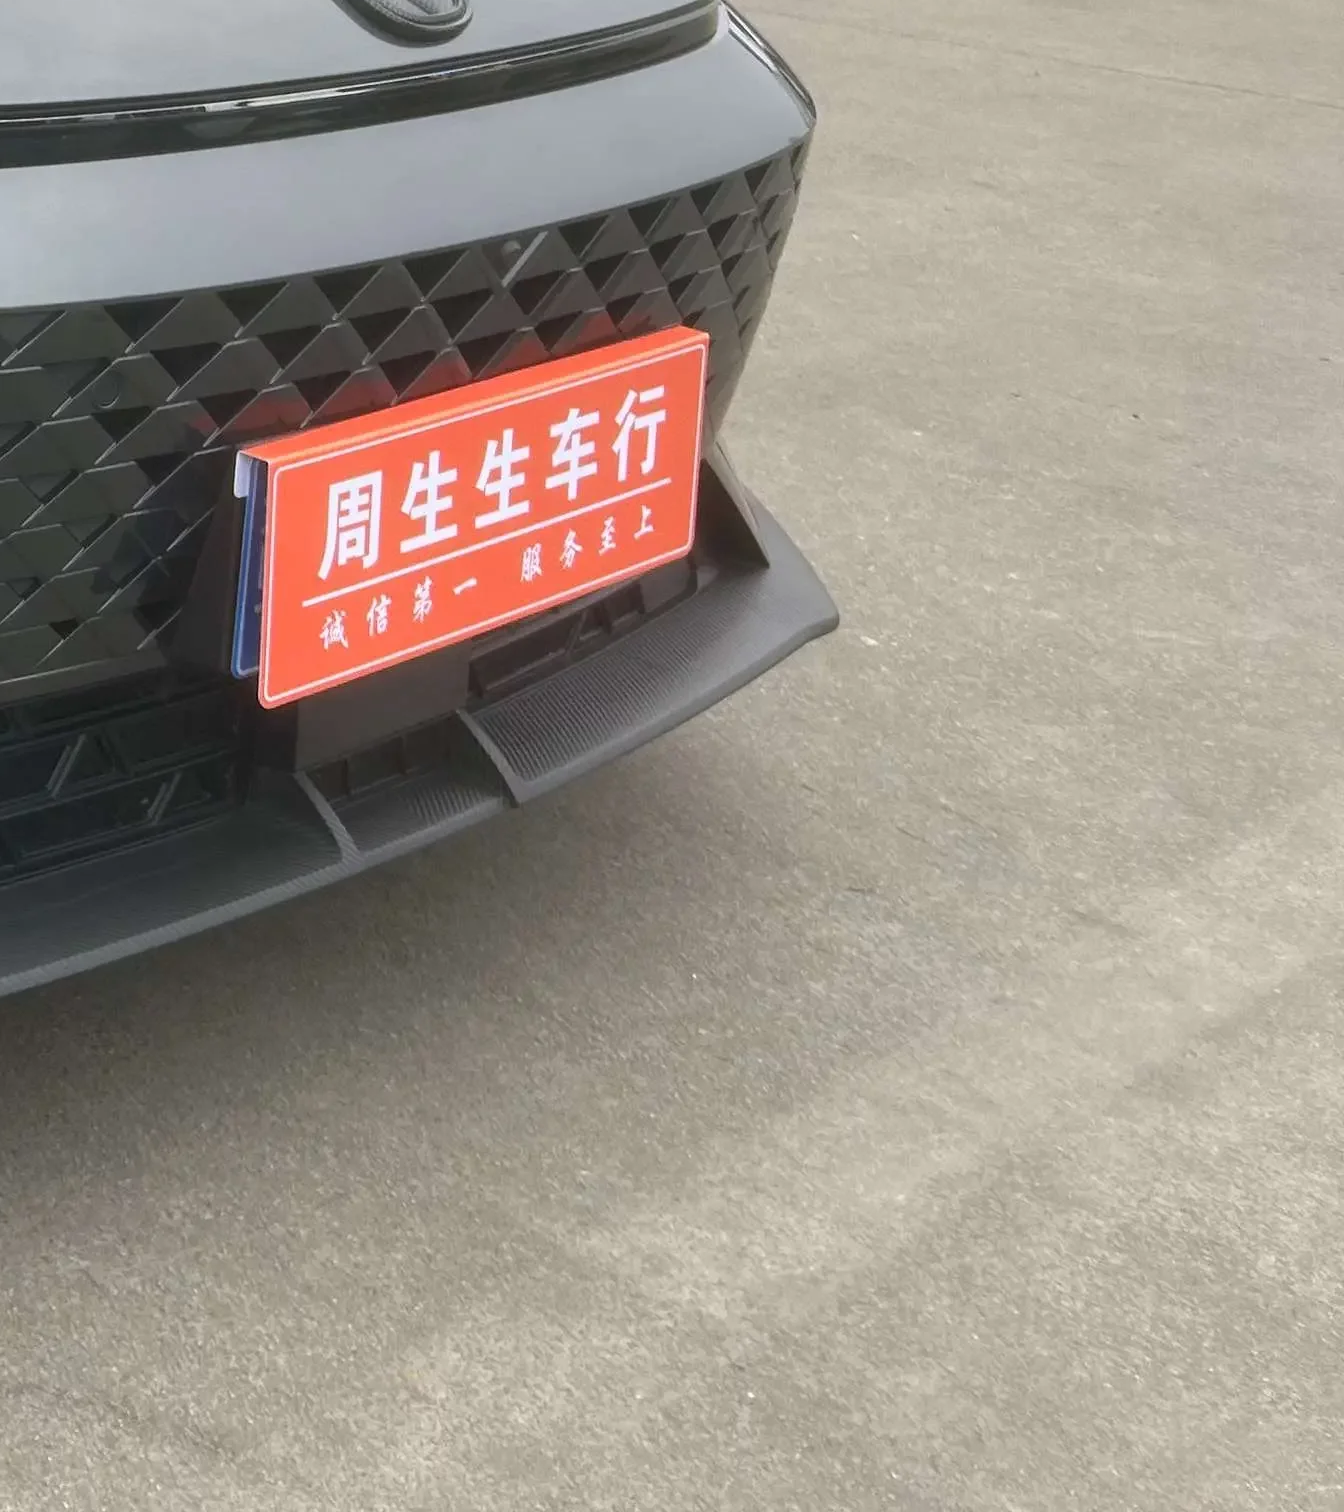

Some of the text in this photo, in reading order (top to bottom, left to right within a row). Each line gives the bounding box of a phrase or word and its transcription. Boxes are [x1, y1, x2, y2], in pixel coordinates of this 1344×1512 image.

[317, 384, 669, 580] 周生生车行
[319, 504, 655, 651] 诚信第一 服务至上
